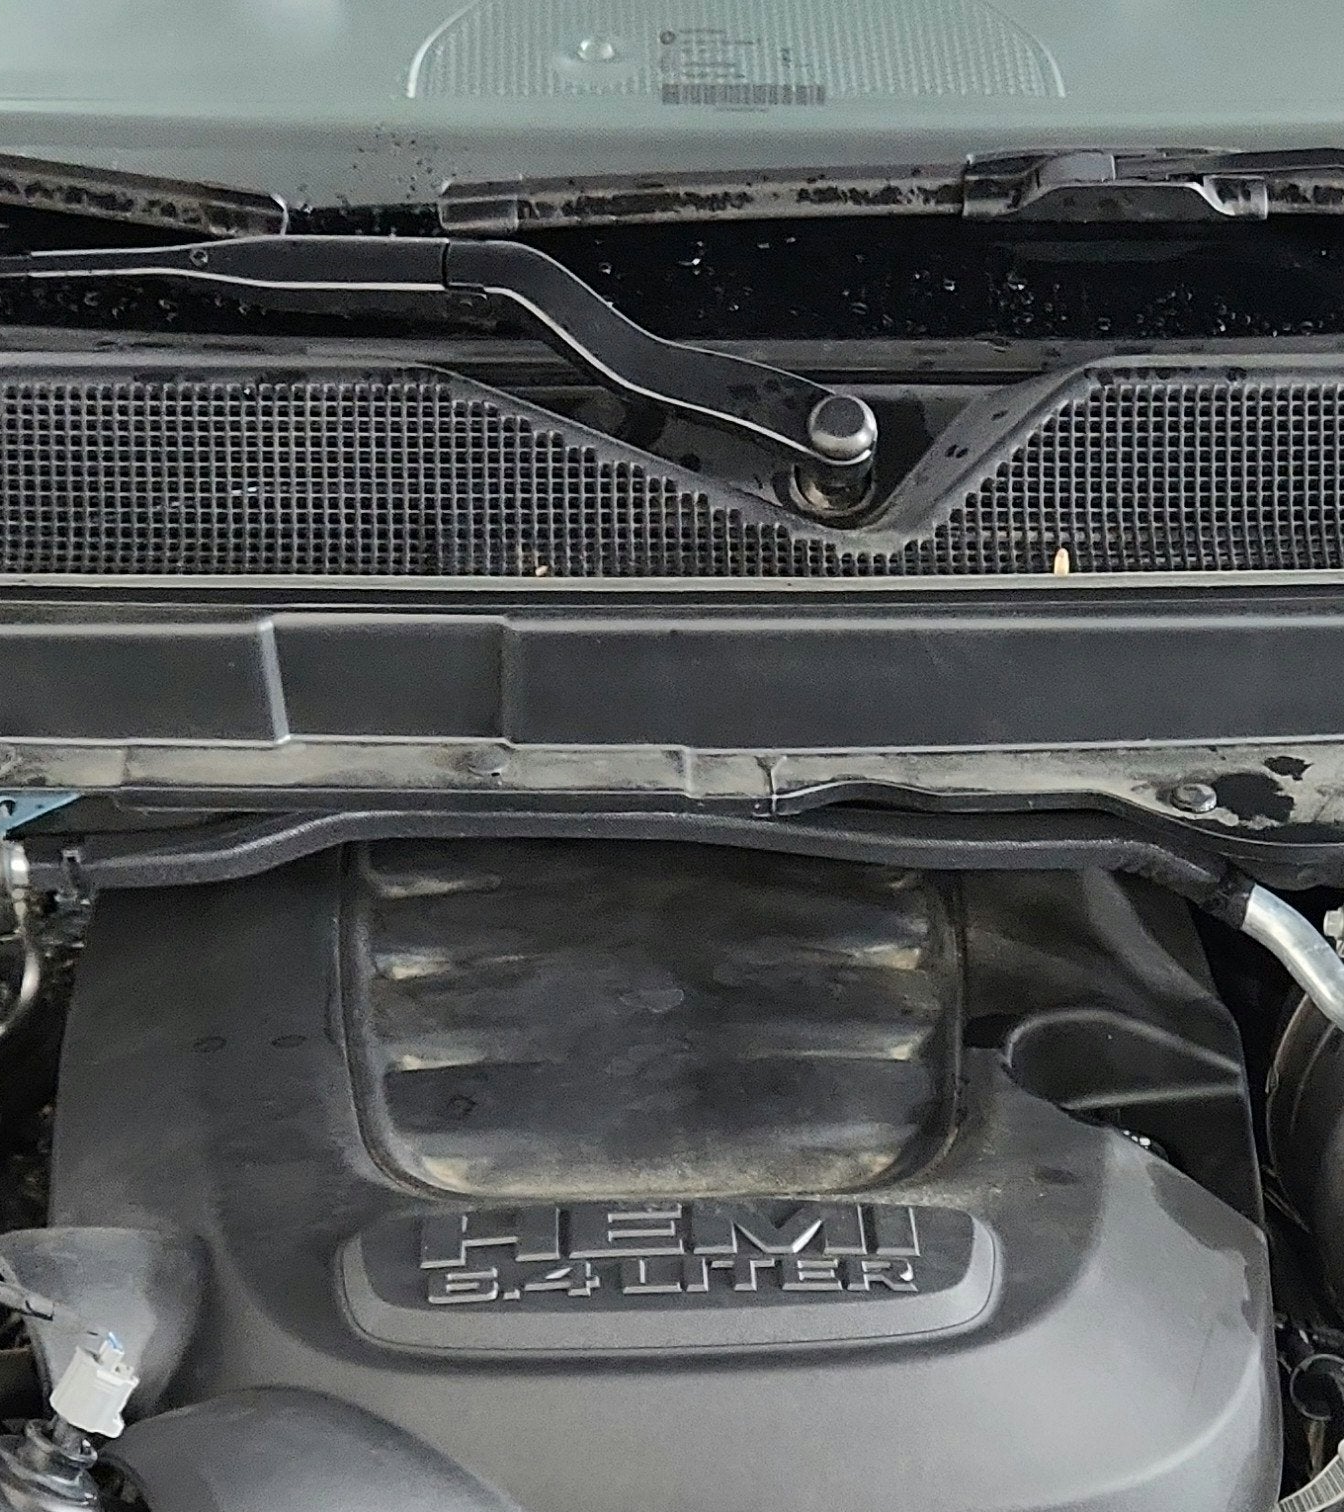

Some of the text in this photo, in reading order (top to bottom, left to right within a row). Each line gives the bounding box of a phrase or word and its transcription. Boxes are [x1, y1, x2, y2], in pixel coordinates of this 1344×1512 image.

[420, 1202, 921, 1270] HEMI
[427, 1257, 919, 1304] 6.4 LITER
